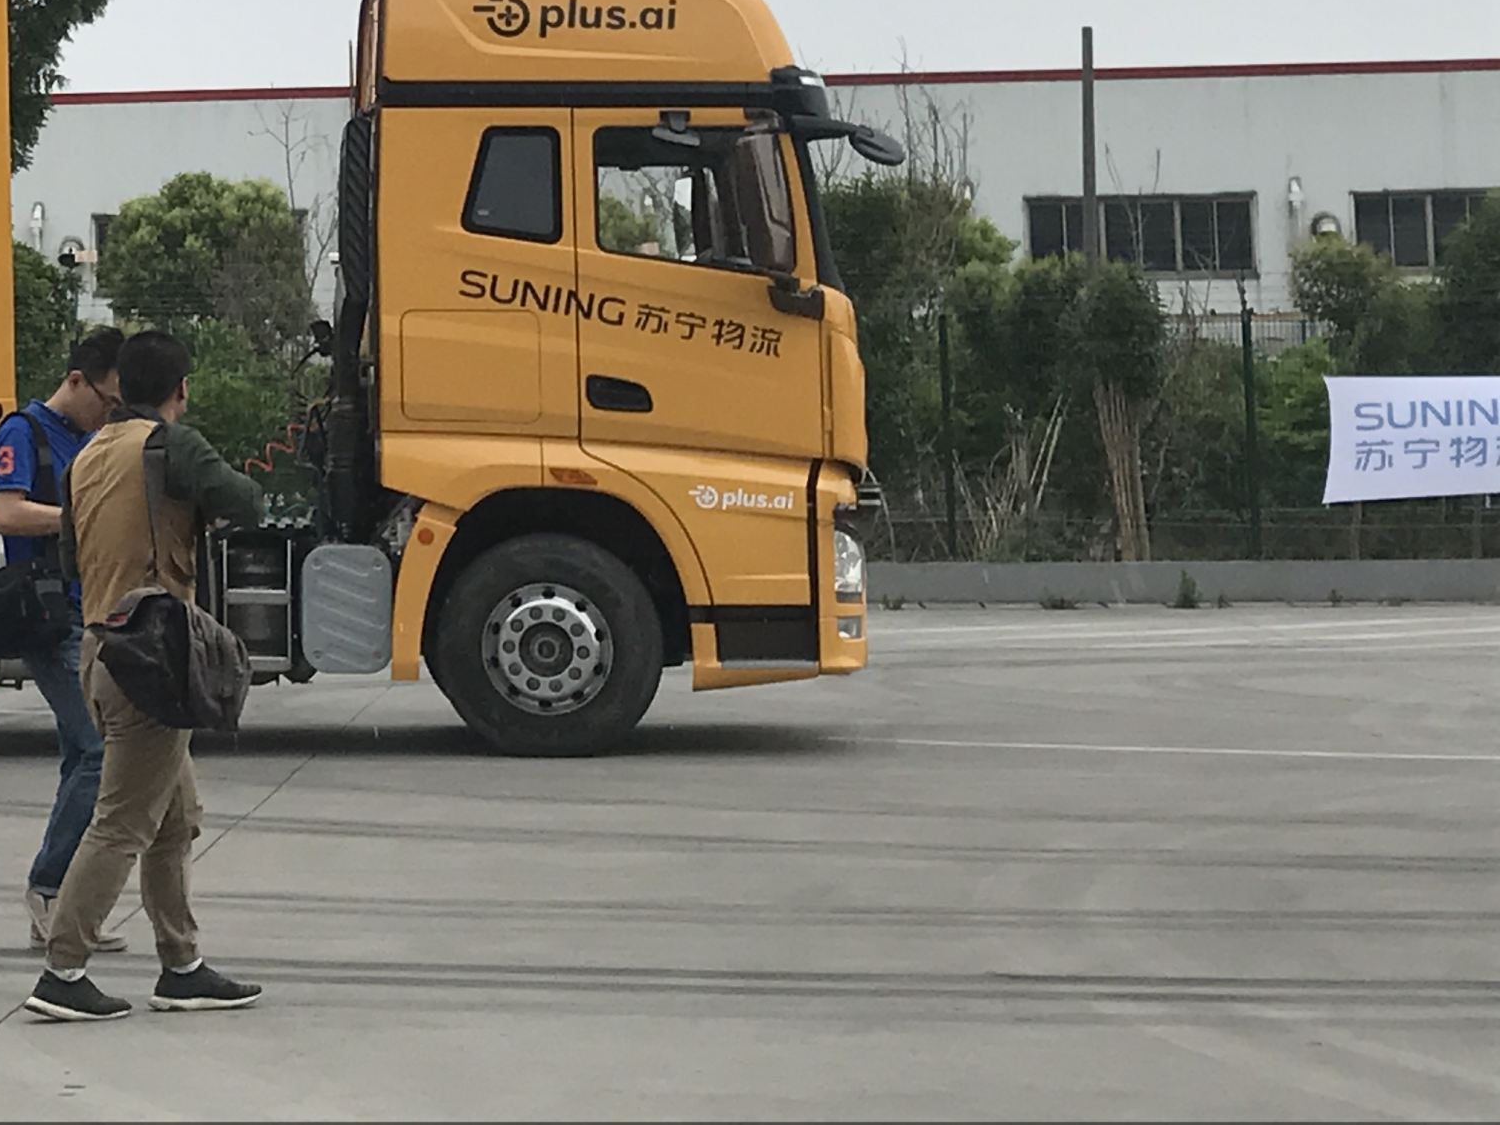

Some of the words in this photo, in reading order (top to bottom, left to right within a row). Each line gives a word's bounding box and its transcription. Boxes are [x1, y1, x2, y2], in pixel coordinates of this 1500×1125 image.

[458, 269, 626, 326] SUNING
[634, 303, 784, 358] 苏宁物流
[1353, 398, 1500, 431] SUNIN
[1354, 435, 1500, 471] 苏宁物
[721, 490, 795, 510] plus.ai
